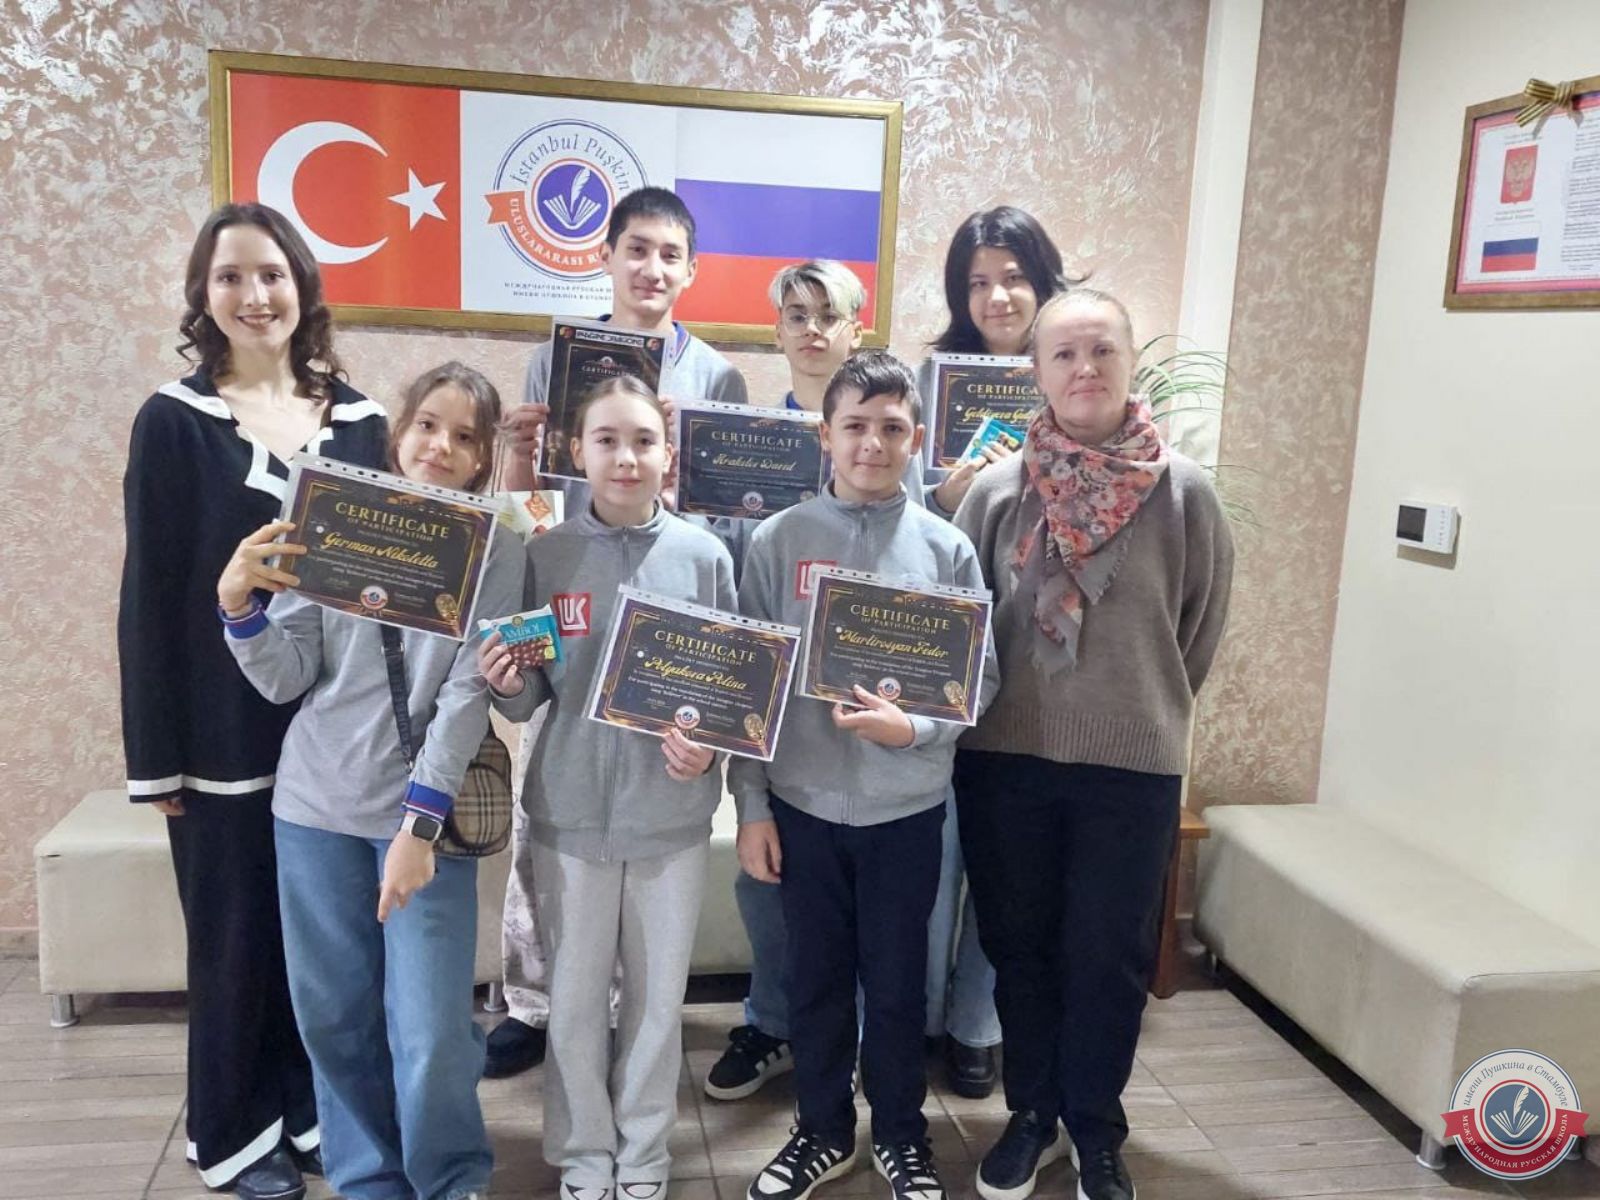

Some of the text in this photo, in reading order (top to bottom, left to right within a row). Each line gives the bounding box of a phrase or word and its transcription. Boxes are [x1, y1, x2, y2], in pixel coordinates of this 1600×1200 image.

[584, 136, 632, 191] Puşkin
[509, 197, 583, 266] ULUSLARARASI
[966, 383, 1039, 396] CERTIFICA
[711, 430, 803, 449] CERTIFICATE
[335, 501, 450, 539] CERTIFICATE
[320, 531, 375, 554] German
[376, 545, 439, 569] Nikoletta
[850, 604, 951, 631] CERTIFICATE
[654, 629, 757, 663] CERTIFICATE
[705, 671, 748, 690] Polina
